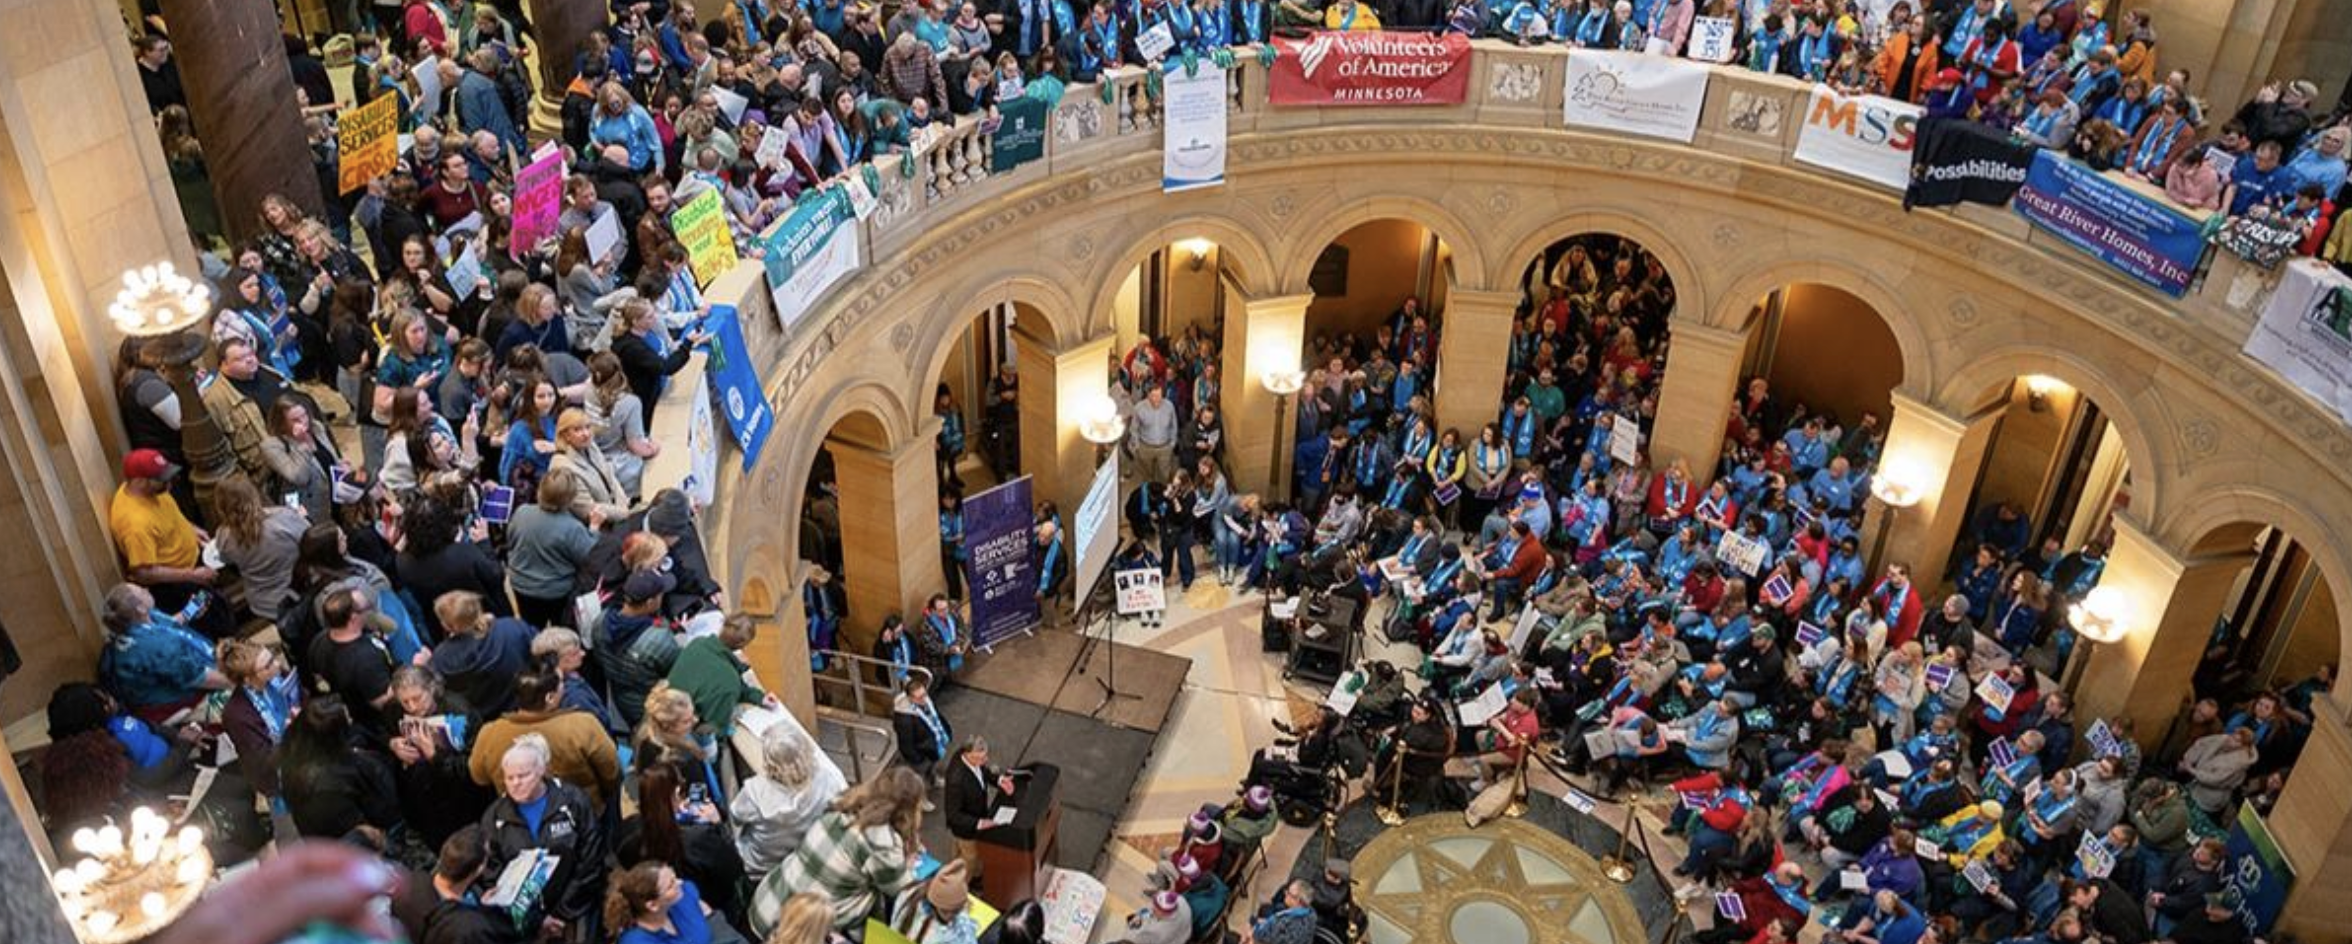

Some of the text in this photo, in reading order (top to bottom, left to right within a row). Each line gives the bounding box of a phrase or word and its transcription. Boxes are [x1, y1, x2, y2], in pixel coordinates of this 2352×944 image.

[1338, 33, 1448, 57] Volunteers
[1338, 57, 1453, 77] of America
[1334, 87, 1423, 100] MINNESOTA
[339, 94, 397, 135] DISABILITY
[1809, 92, 1918, 151] MSS
[341, 112, 396, 156] SERVICES
[778, 222, 813, 258] Inclusion
[2018, 185, 2058, 214] Great
[2058, 204, 2101, 237] River
[2101, 226, 2157, 272] Homes,
[2159, 258, 2189, 285] Inc
[974, 539, 1029, 565] SERVICES
[975, 528, 1028, 556] DISABILITY
